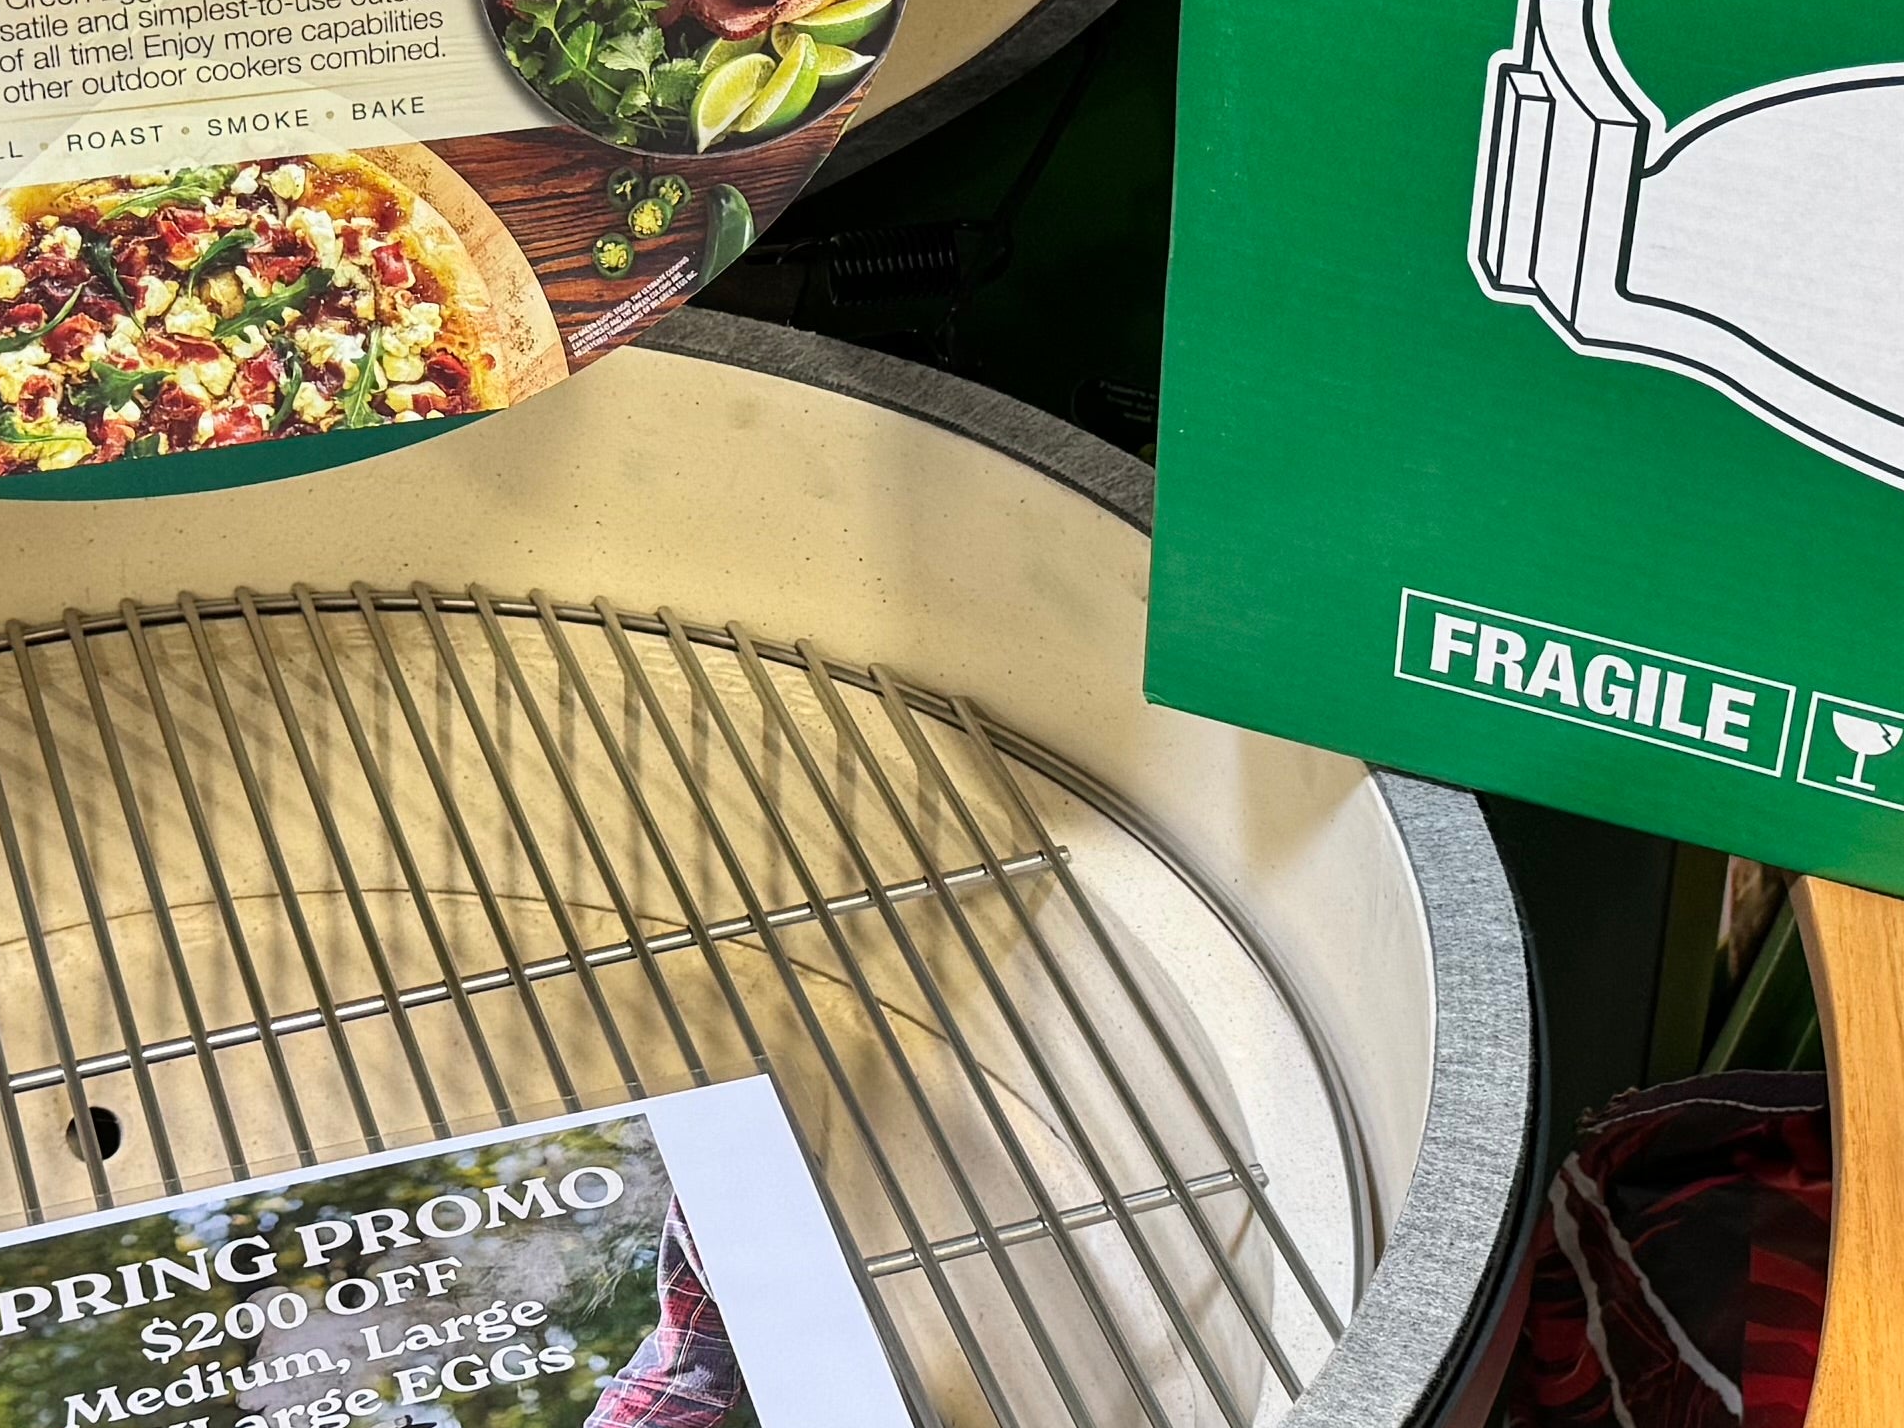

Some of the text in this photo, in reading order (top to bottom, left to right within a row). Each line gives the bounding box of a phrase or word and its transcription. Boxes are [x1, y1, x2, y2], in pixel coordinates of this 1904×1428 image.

[0, 48, 25, 73] of
[33, 44, 62, 71] all
[71, 37, 134, 66] time!
[143, 33, 216, 61] Enjoy
[224, 25, 293, 51] more
[301, 8, 445, 45] capabilities
[77, 7, 130, 35] and
[3, 78, 74, 105] other
[82, 65, 188, 96] outdoor
[195, 55, 303, 85] cookers
[310, 35, 447, 72] combined.
[66, 124, 164, 153] ROAST
[207, 109, 311, 138] SMOKE
[351, 96, 426, 121] BAKE
[1429, 611, 1757, 752] FRAGILE
[294, 1165, 625, 1268] PROMO
[140, 1255, 463, 1366] $200 OFF
[361, 1298, 549, 1364] Large
[392, 1341, 577, 1407] EGGs
